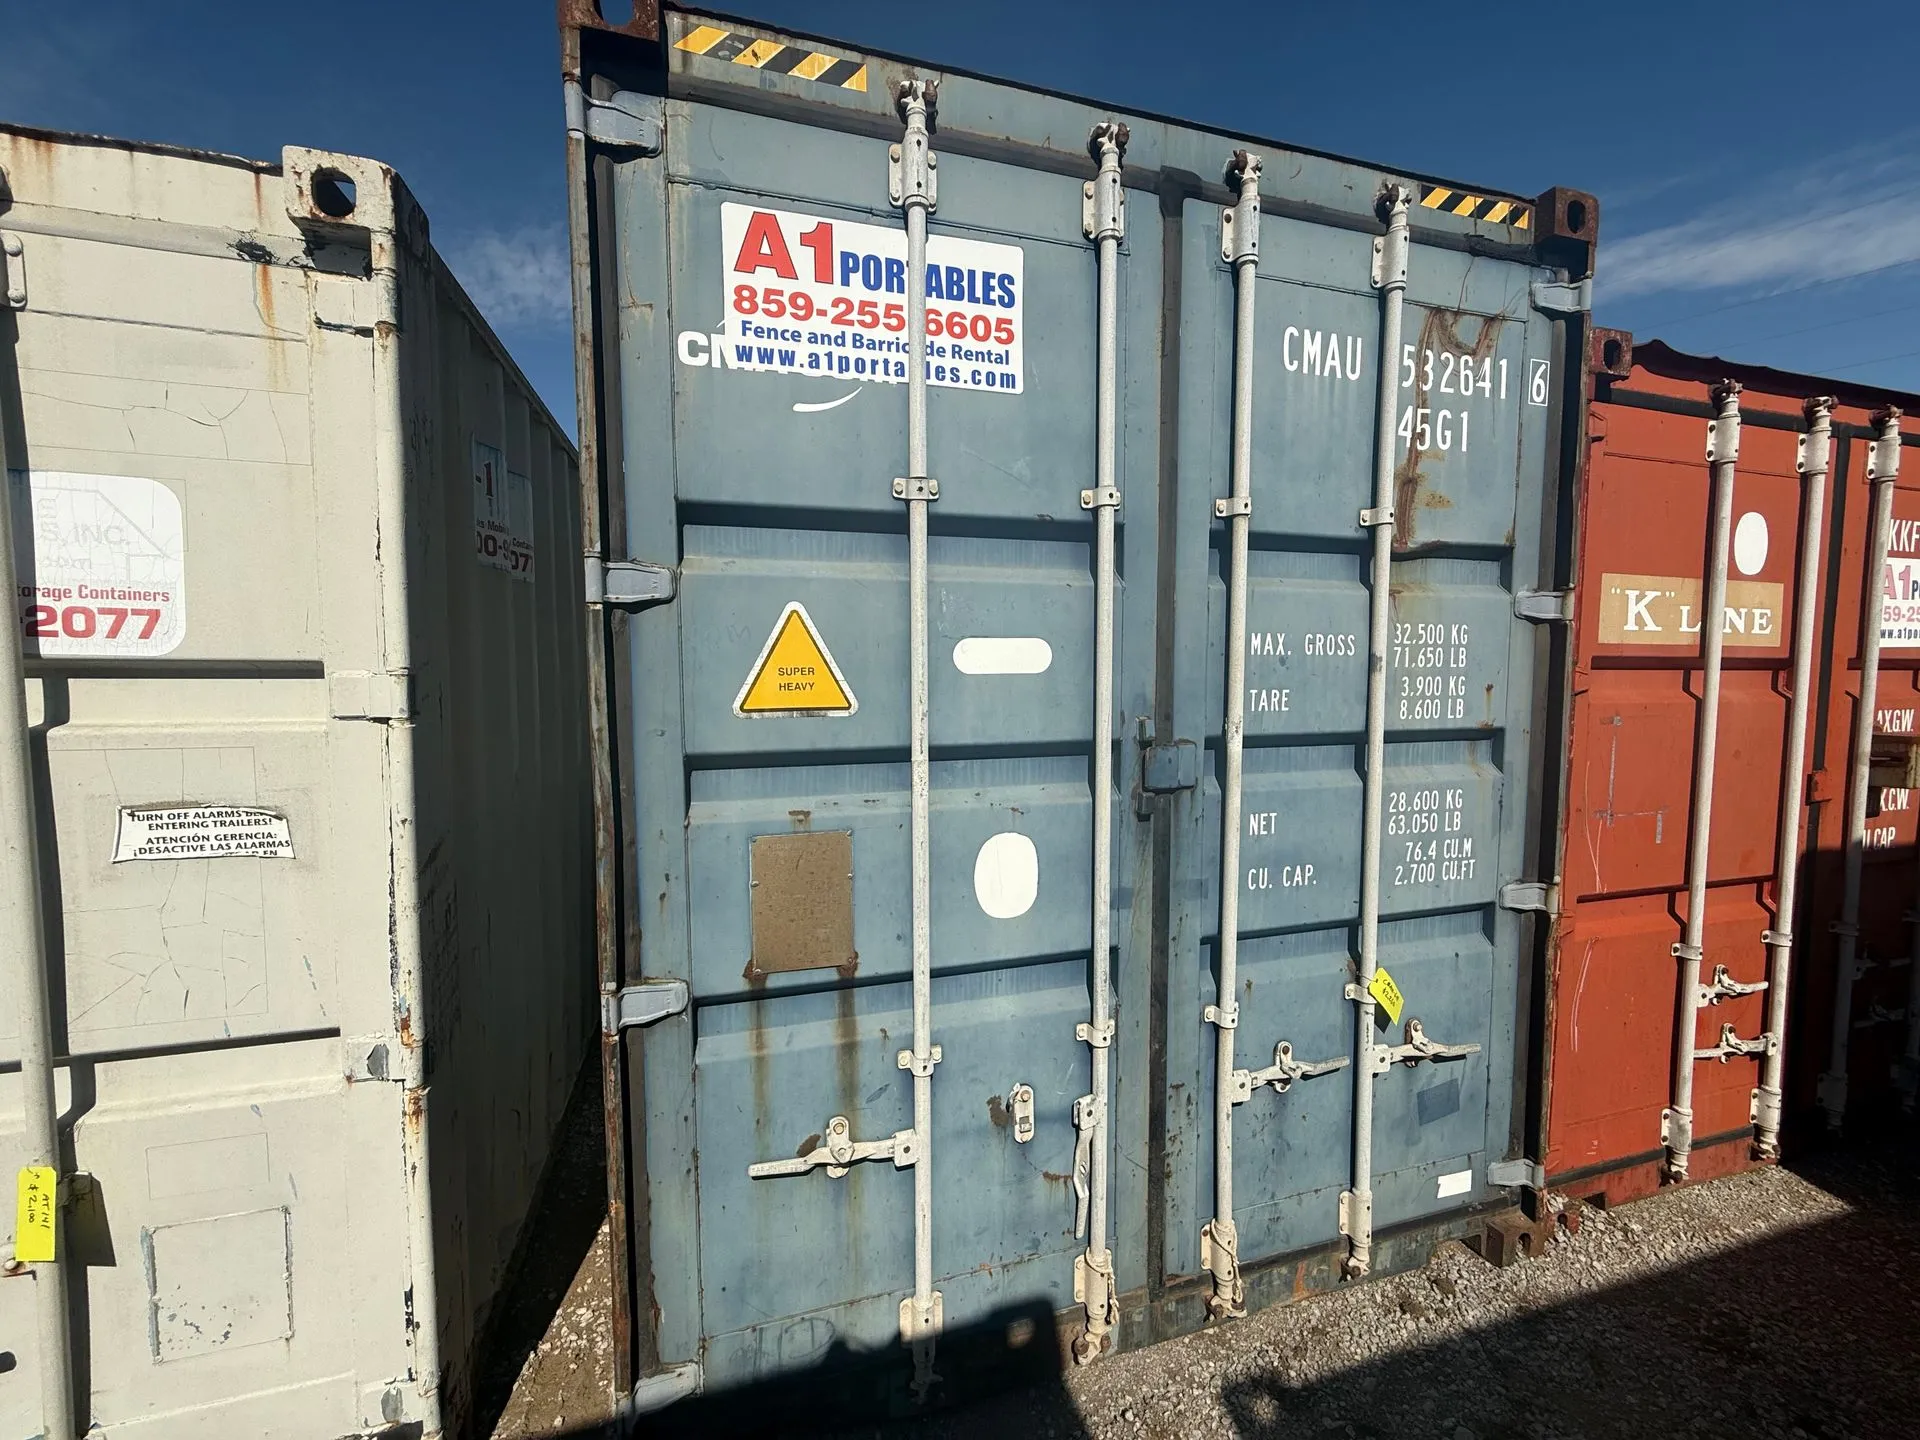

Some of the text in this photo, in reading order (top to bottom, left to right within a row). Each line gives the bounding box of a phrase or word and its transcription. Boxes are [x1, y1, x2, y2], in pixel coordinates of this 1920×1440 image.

[734, 211, 1016, 309] A1 PORABLES
[733, 284, 1015, 345] 859-2556605
[741, 320, 1009, 366] Fence and Barricde Rental
[736, 344, 1016, 389] www.a1portales.com
[1283, 326, 1549, 405] CMAU 532641 6
[1397, 405, 1469, 452] 45G1
[78, 584, 170, 602] Containers
[20, 605, 161, 640] 2077
[1679, 606, 1773, 634] LNE
[1250, 632, 1356, 656] MAX. GROSS
[1394, 623, 1468, 645] 32,500 KG
[1393, 646, 1467, 668] 71,650 LB
[778, 667, 815, 676] SUPER
[779, 682, 815, 691] HEAVY
[1401, 676, 1466, 697] 3,900 KG
[1250, 689, 1290, 711] TARE
[1399, 699, 1464, 720] 8,600 LB
[1389, 789, 1463, 813] 28,600 KG
[131, 813, 163, 822] TURN
[168, 812, 190, 820] OFF
[193, 810, 242, 820] ALARMS
[148, 818, 272, 831] ENTERING TRAILERS!
[1249, 813, 1278, 835] NET
[1388, 811, 1461, 835] 63,050 LB
[133, 840, 291, 857] ¡DESACTIVE LAS ALARMAS
[146, 832, 277, 845] ATENCIÓN GERENCIA:
[1405, 838, 1472, 862] 76.4 CU.M
[1248, 864, 1317, 890] CU. CAP.
[1394, 859, 1476, 886] 2,700 CU.FT
